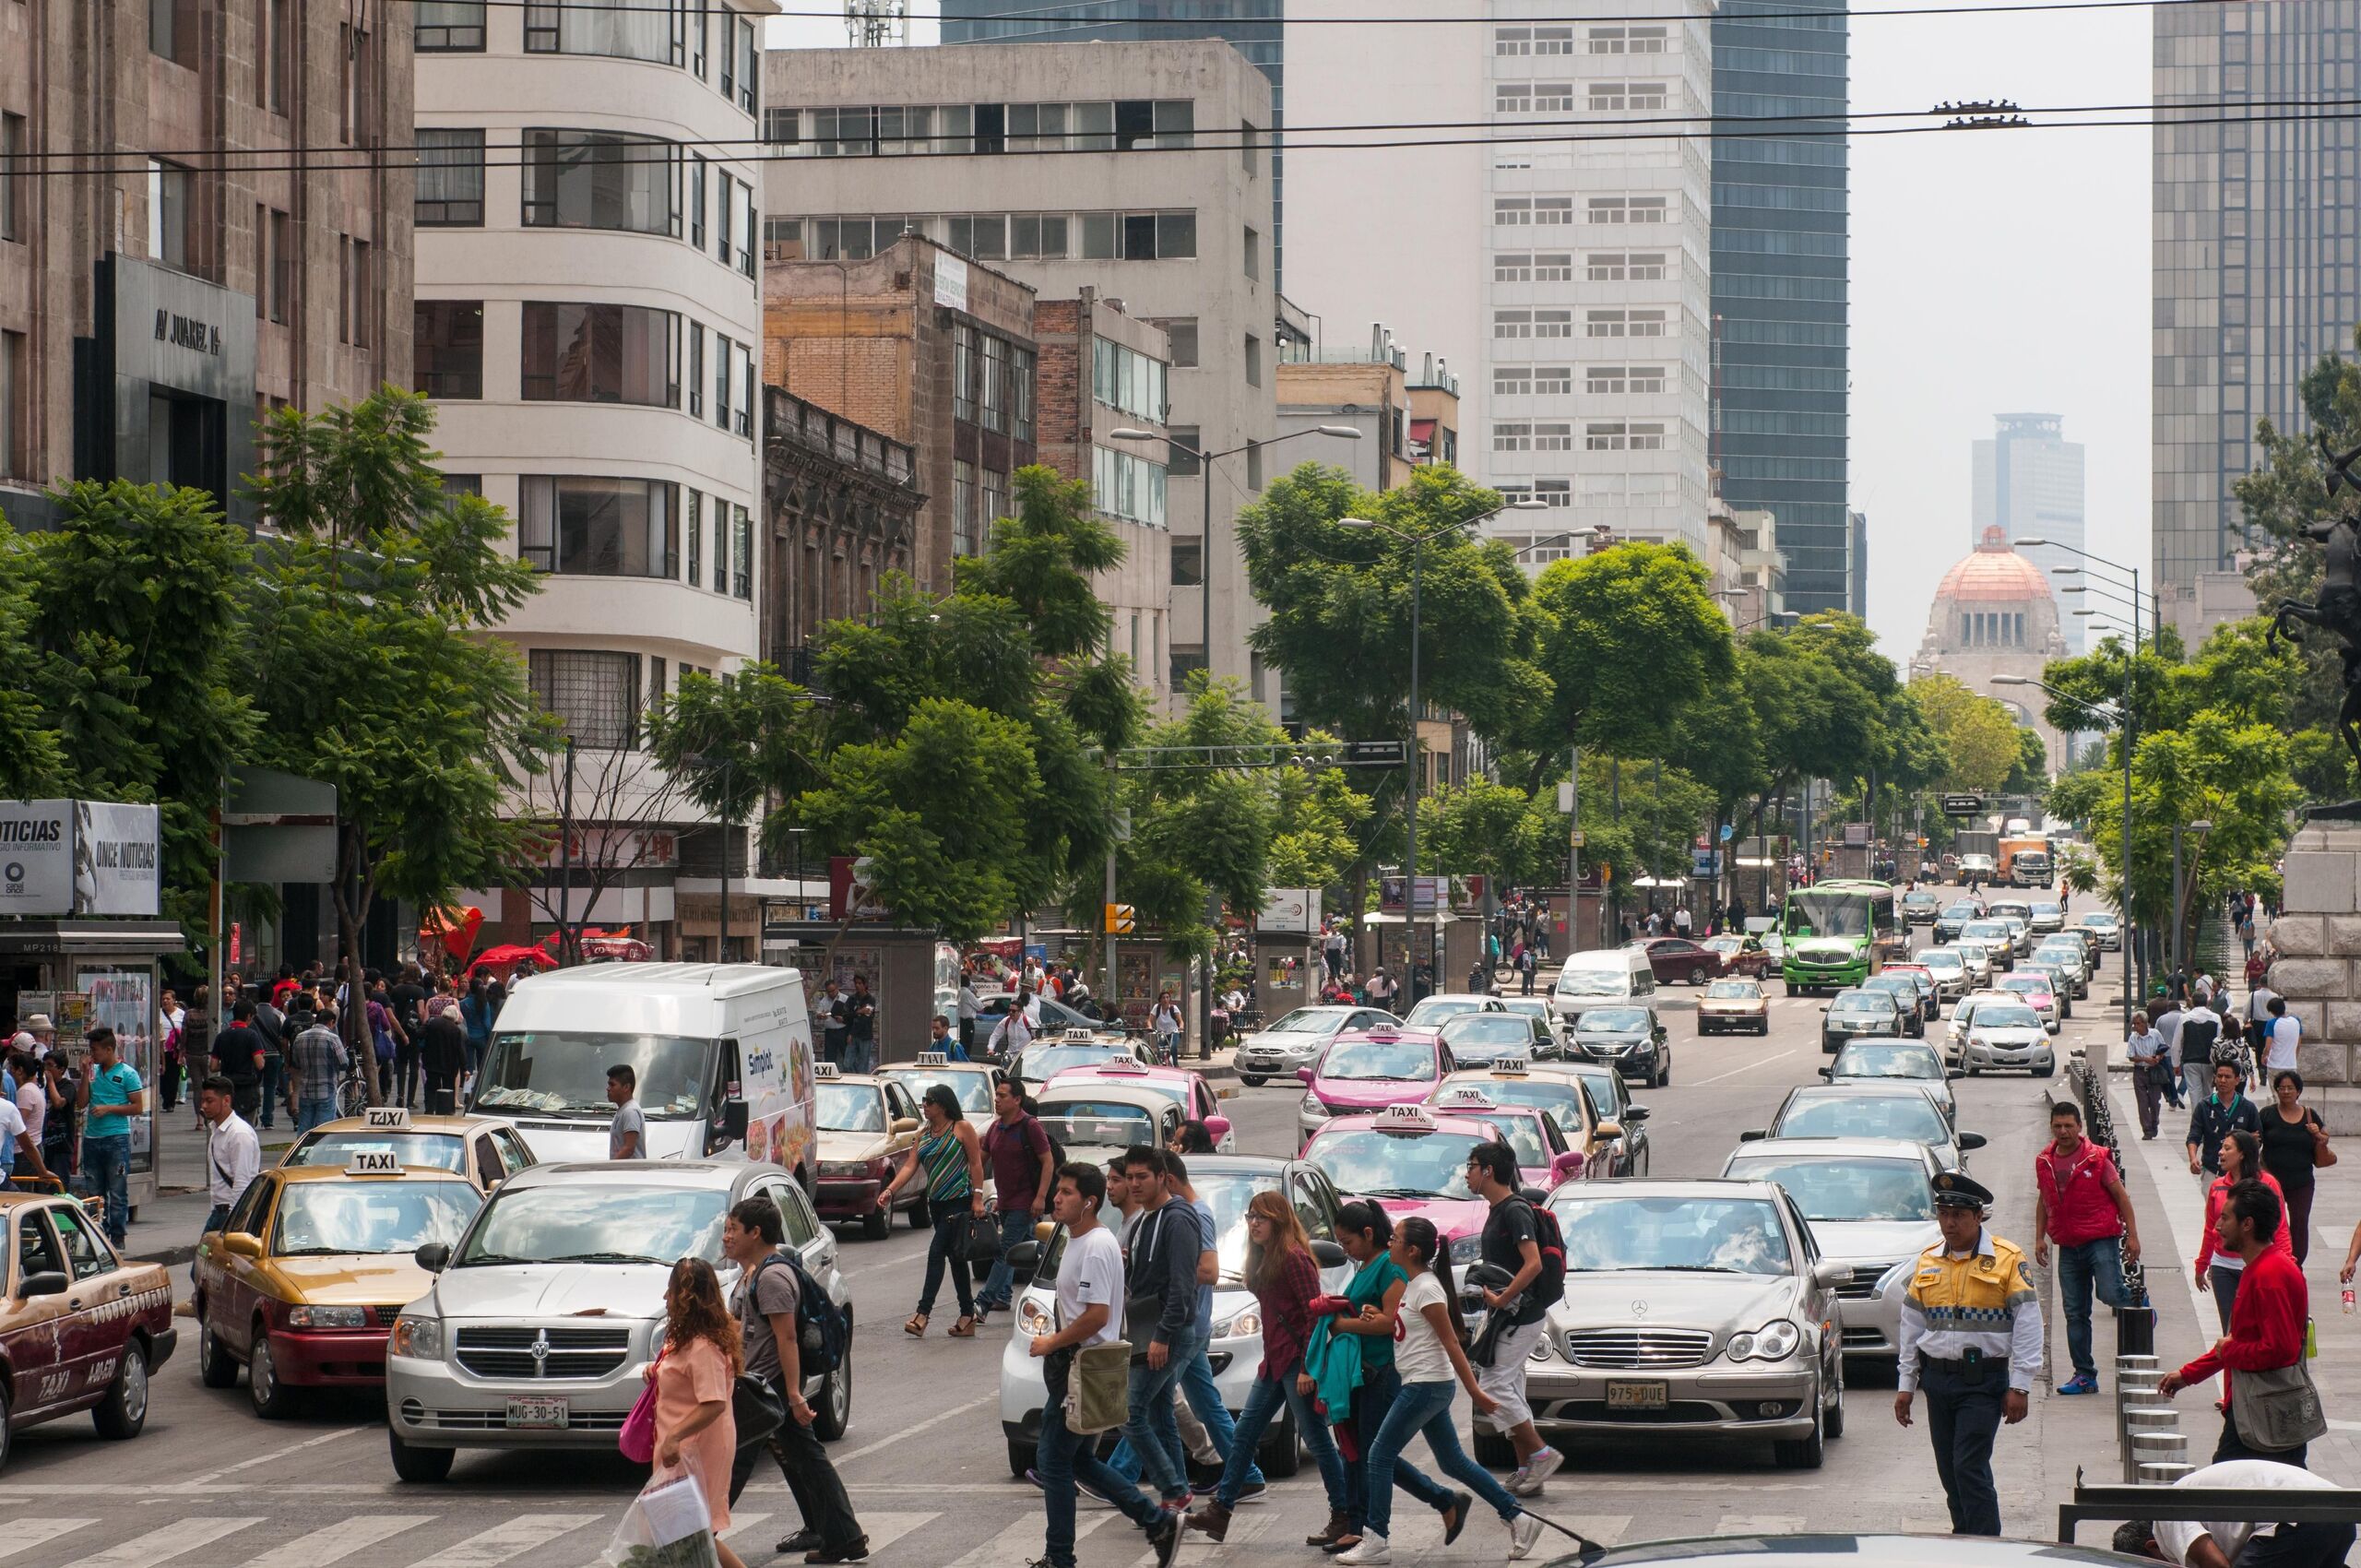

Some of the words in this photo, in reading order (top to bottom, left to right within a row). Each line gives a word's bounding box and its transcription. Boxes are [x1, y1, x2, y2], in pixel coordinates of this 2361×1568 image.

[210, 326, 221, 356] 14
[0, 820, 61, 842] TICIAS
[12, 842, 61, 851] INFORMATIVO
[96, 840, 118, 868] ONCE
[120, 842, 155, 869] NOTICIAS
[96, 980, 113, 1003] ONCE
[748, 1048, 773, 1079] Simplot
[919, 1054, 943, 1063] TAXI
[1497, 1060, 1524, 1070] TAXI
[814, 1065, 832, 1076] AXI
[1457, 1090, 1479, 1099] TAXI
[369, 1111, 403, 1126] TAXI
[1390, 1107, 1418, 1117] TAXI
[356, 1154, 395, 1170] TAXI
[38, 1370, 71, 1399] TAXI
[508, 1405, 565, 1420] MUG-30-51
